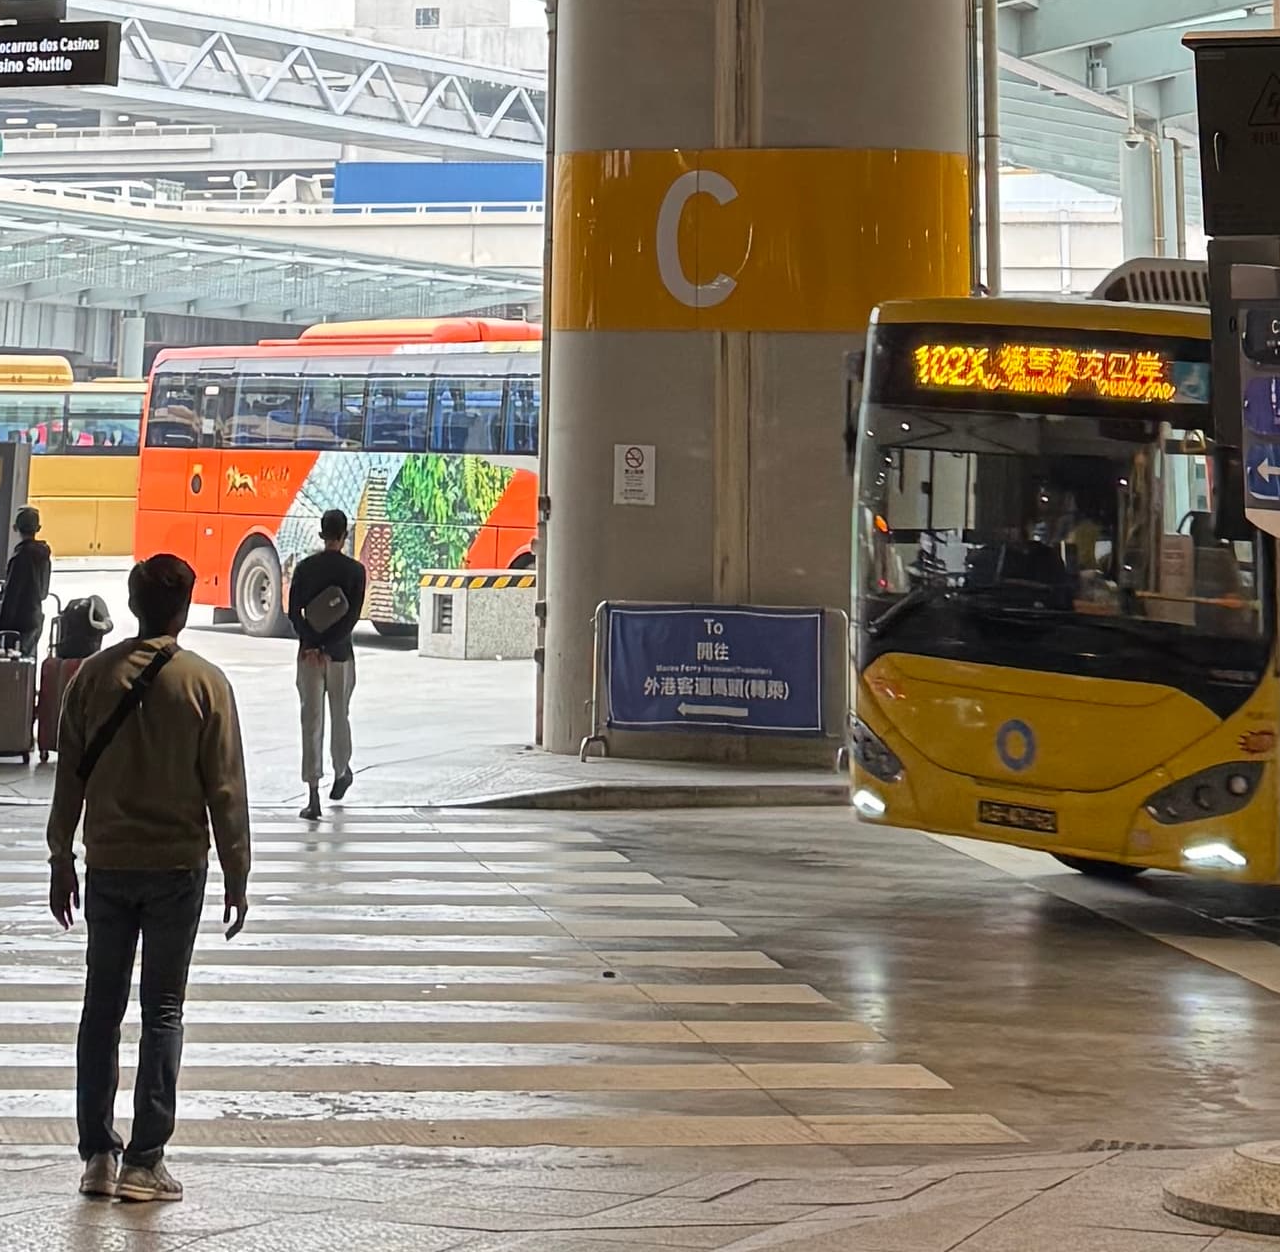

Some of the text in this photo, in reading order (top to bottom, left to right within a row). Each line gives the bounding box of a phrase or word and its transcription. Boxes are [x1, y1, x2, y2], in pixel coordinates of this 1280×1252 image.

[39, 39, 58, 52] dos
[60, 37, 99, 51] Casinos
[26, 56, 72, 73] Shuttle
[656, 170, 739, 308] C
[703, 619, 724, 635] To
